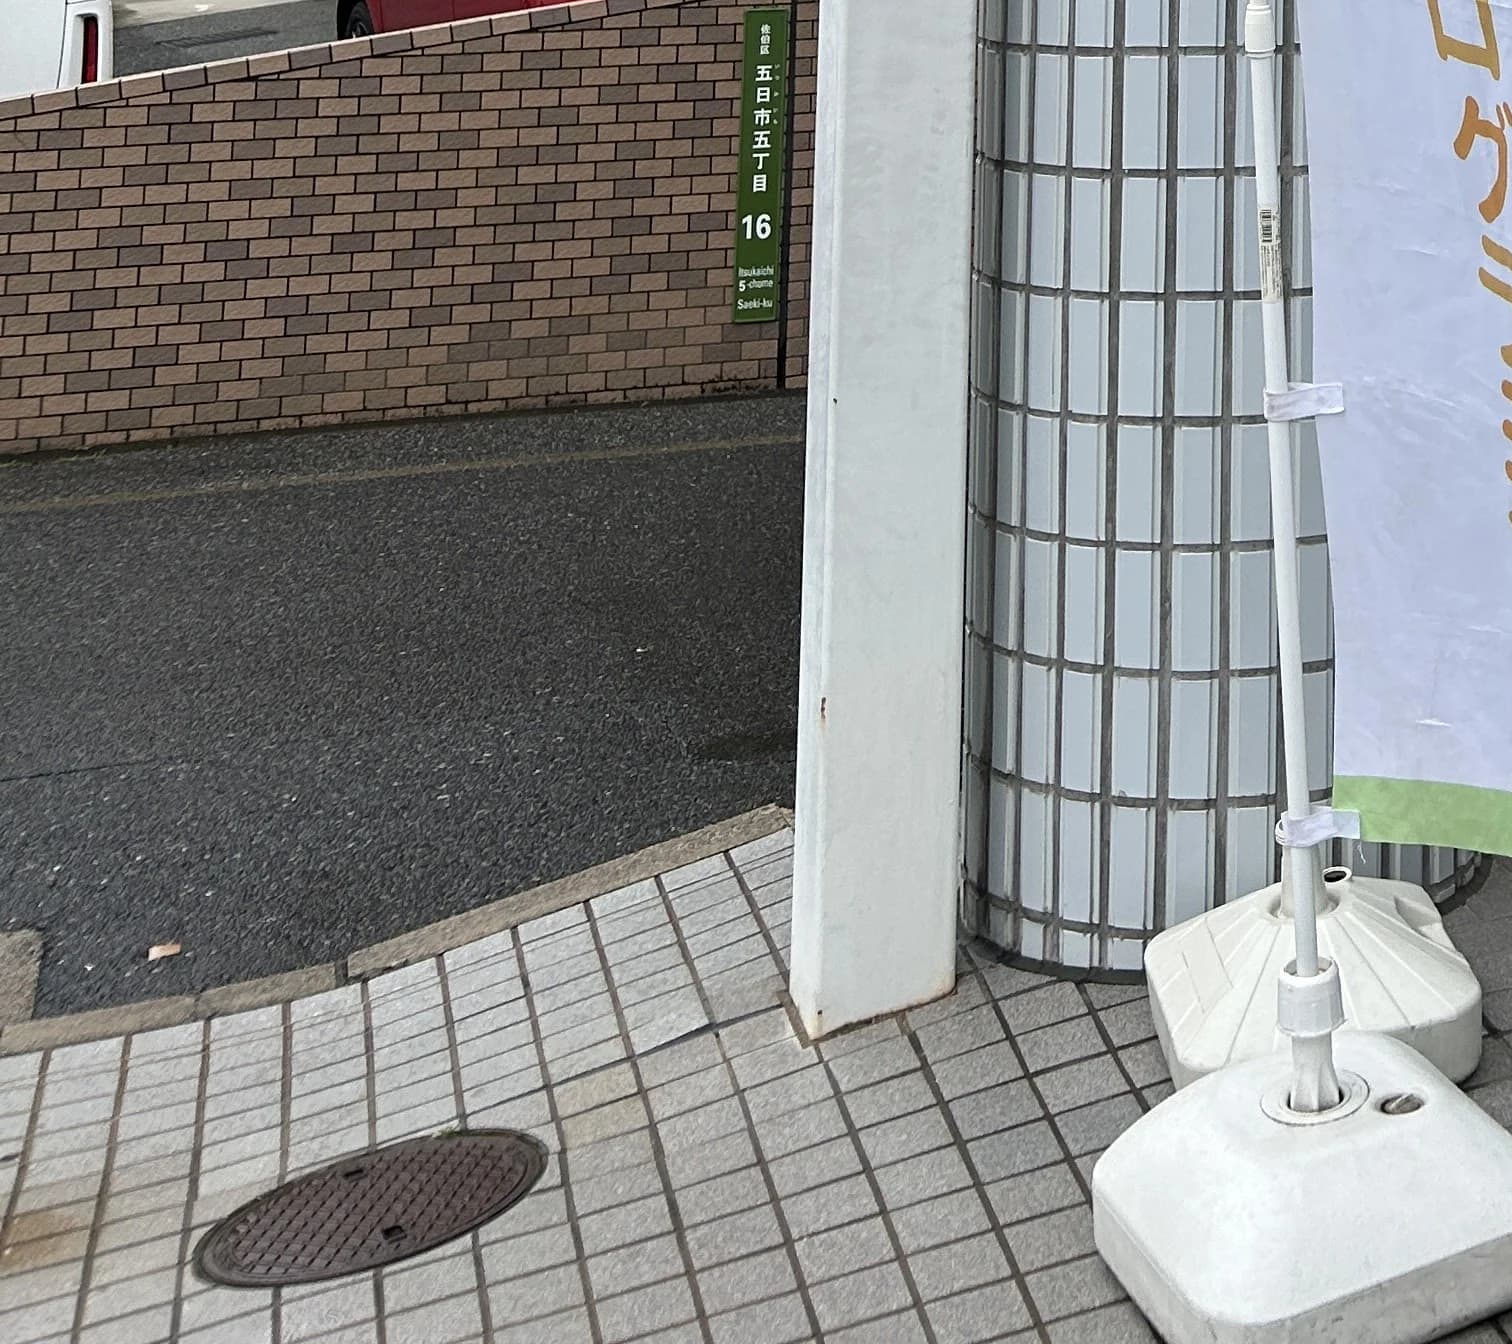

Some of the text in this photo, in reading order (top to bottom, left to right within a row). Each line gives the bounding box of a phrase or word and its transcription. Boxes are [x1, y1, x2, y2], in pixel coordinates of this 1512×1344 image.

[752, 64, 773, 193] 五日市五丁目
[741, 213, 772, 240] 16
